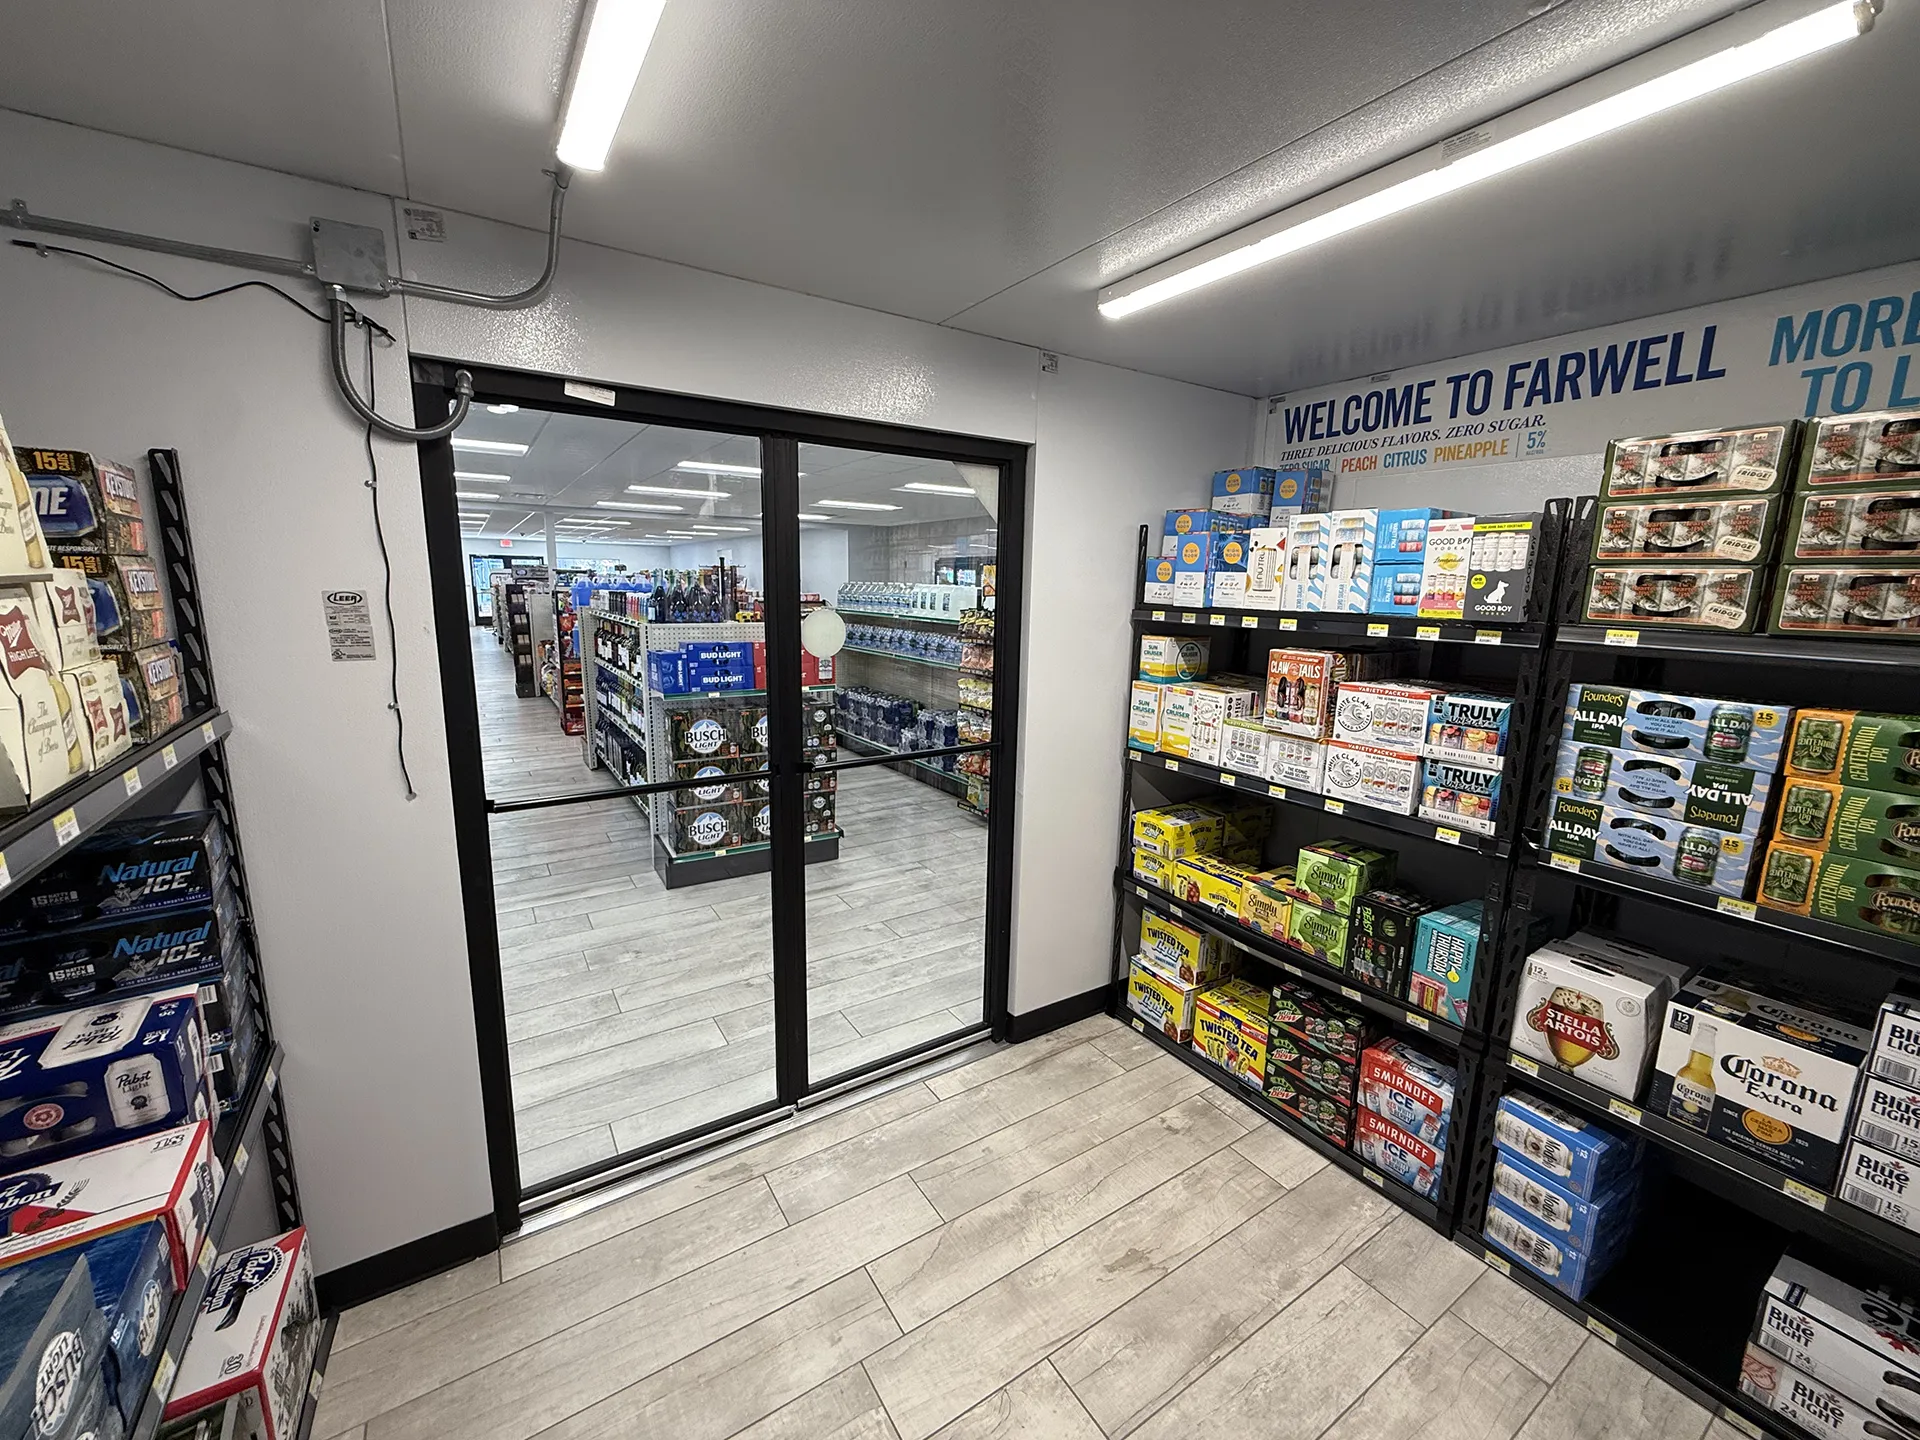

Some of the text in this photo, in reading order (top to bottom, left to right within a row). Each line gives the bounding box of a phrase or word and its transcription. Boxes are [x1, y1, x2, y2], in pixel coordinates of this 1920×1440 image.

[1284, 325, 1726, 444] WELCOME TO FARWELL
[1801, 361, 1873, 418] TO
[1280, 414, 1546, 462] THREE DELICIOUS FLAVORS. ZERO SUGAR.
[1527, 430, 1547, 449] 5%
[33, 452, 58, 470] 15
[1341, 438, 1510, 473] PEACH CITRUS PINEAPPLE
[1738, 470, 1772, 478] FRIDGE!
[1722, 540, 1756, 551] FRIDGE!
[1709, 607, 1742, 618] FRIDGE!
[703, 674, 744, 683] BUD LIGHT
[1271, 660, 1321, 678] CLAW TAILS
[1132, 705, 1155, 715] CRUISER
[1138, 699, 1150, 707] SUN
[1172, 703, 1184, 711] SUN
[1338, 696, 1371, 717] WHITE CLAW
[1449, 702, 1503, 722] TRULY
[1166, 709, 1190, 719] CRUISER
[1573, 711, 1628, 728] ALL DAY
[1757, 712, 1774, 721] 15
[685, 727, 727, 745] BUSCH
[694, 741, 718, 749] LIGHT
[1327, 753, 1360, 773] WHITE CLAW
[1850, 725, 1882, 782] CENTENNIAL
[1869, 747, 1891, 763] IPA
[1443, 766, 1494, 788] TRULY
[1712, 782, 1729, 790] IPA
[698, 787, 723, 796] LIGHT
[1686, 784, 1754, 806] ALL DAY
[689, 820, 730, 838] BUSCH
[1549, 820, 1601, 841] ALL DAY
[1838, 796, 1870, 852] CENTENNIAL
[1858, 818, 1879, 834] IPA
[697, 833, 721, 841] LIGHT
[1567, 833, 1580, 841] IPA
[1723, 839, 1739, 848] 15
[99, 851, 199, 885] Natural
[1311, 864, 1346, 890] Simply
[143, 871, 193, 895] ICE
[1818, 863, 1849, 918] CENTENNIAL
[1837, 886, 1857, 901] IPA
[1208, 893, 1237, 910] TWISTED TEA
[1248, 893, 1278, 918] Simply
[1304, 915, 1338, 943] Simply
[113, 921, 212, 959] Natural
[1147, 927, 1190, 958] TWISTED TEA
[157, 940, 206, 966] ICE
[1432, 932, 1451, 979] THURSDAY
[1449, 936, 1465, 971] HAPPY
[49, 968, 66, 982] 15
[1133, 981, 1175, 1016] TWISTED TEA
[1546, 1008, 1602, 1037] STELLA
[1677, 1011, 1689, 1024] 12
[62, 1028, 124, 1051] Pabst
[142, 1033, 167, 1047] 12
[1199, 1019, 1259, 1062] TWISTED TEA
[1543, 1020, 1601, 1046] ARTOIS
[115, 1070, 153, 1089] Pabst
[122, 1083, 150, 1094] Light
[1373, 1067, 1435, 1105] SMIRNOFF
[1721, 1054, 1838, 1113] Corona
[1388, 1089, 1415, 1110] ICE
[1676, 1081, 1711, 1102] Corona
[1745, 1080, 1803, 1115] Extra
[1369, 1118, 1429, 1159] SMIRNOFF
[1384, 1140, 1408, 1161] ICE
[1858, 1154, 1910, 1183] Blue
[1855, 1166, 1908, 1195] LIGHT
[242, 1250, 274, 1285] Pabst
[210, 1248, 247, 1312] Blue Ribbon
[1768, 1305, 1815, 1338] Blue
[1767, 1316, 1814, 1349] LIGHT
[225, 1353, 244, 1375] 30
[1796, 1352, 1812, 1365] 24
[1792, 1380, 1845, 1419] Blue
[1779, 1402, 1799, 1419] 24
[1790, 1392, 1844, 1430] LIGHT
